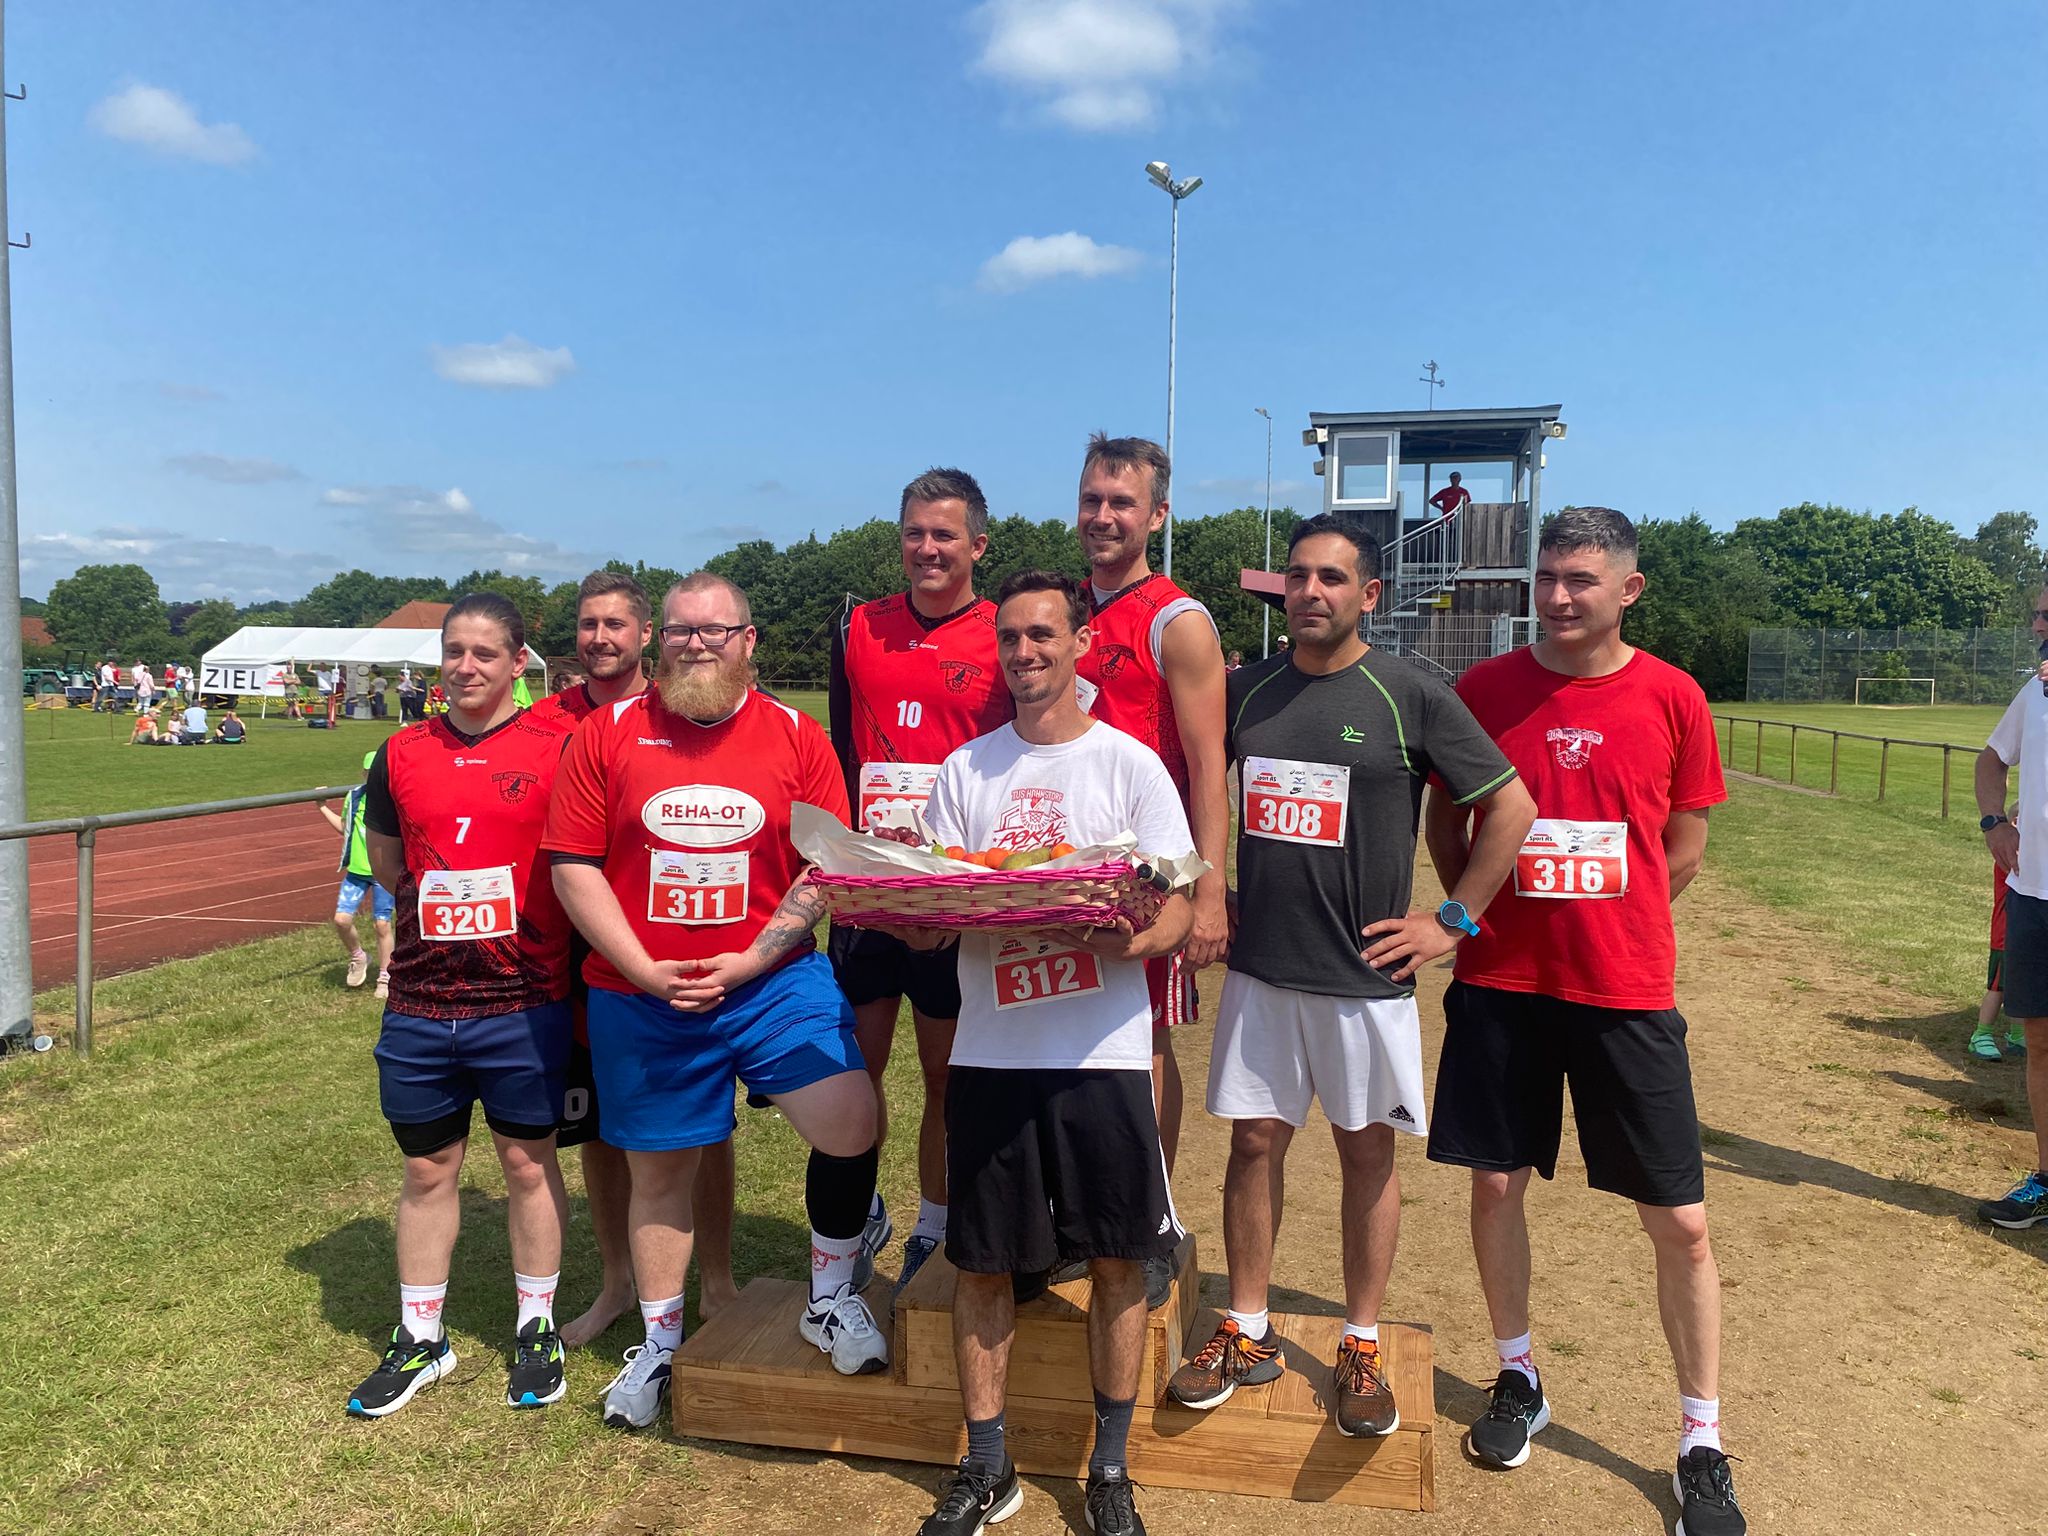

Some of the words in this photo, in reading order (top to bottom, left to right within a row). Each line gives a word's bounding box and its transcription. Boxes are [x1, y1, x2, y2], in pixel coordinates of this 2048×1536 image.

[204, 669, 261, 690] ZIEL
[897, 700, 922, 729] 10
[1012, 789, 1026, 799] TUS
[661, 804, 746, 820] REHA-OT
[1258, 798, 1323, 837] 308
[455, 817, 472, 844] 7
[997, 822, 1065, 848] POKAL
[1533, 858, 1604, 893] 316
[667, 888, 725, 919] 311
[435, 903, 497, 935] 320
[1010, 957, 1080, 1000] 312
[1388, 1112, 1416, 1124] adidas
